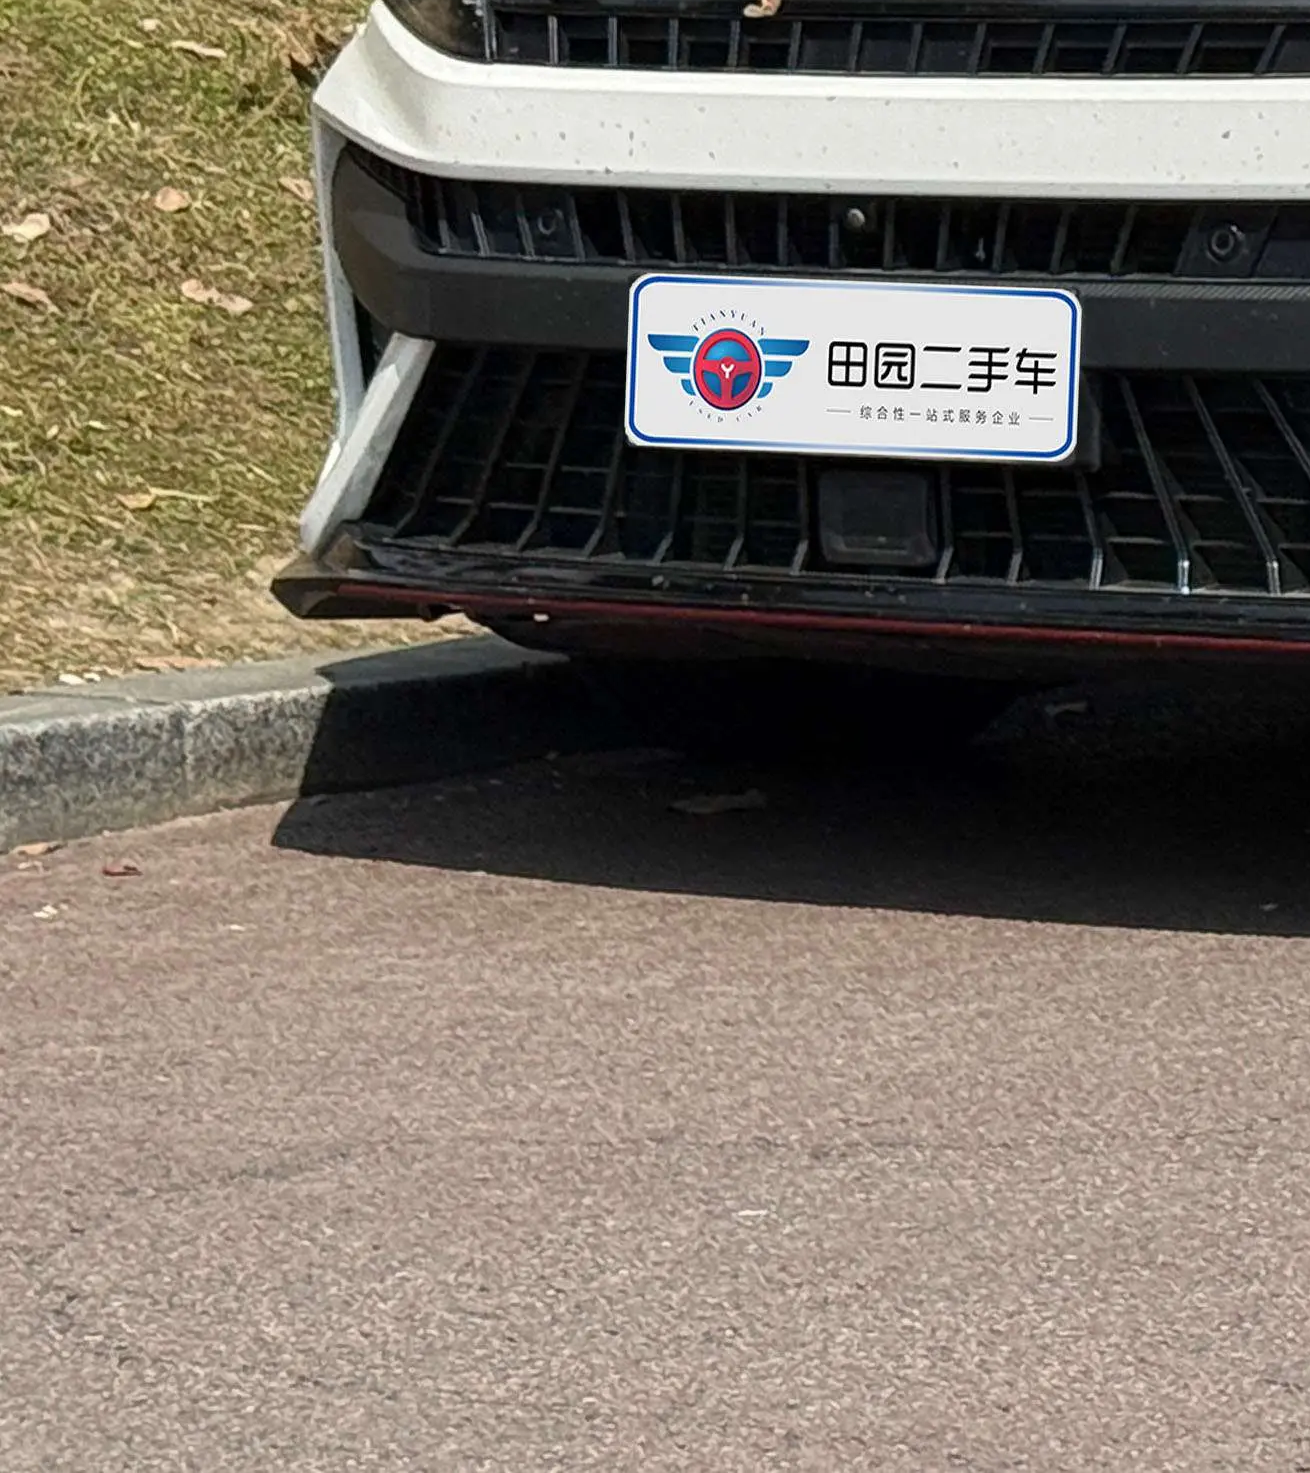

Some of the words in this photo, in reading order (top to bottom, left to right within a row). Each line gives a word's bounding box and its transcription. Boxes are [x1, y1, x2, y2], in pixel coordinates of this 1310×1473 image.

[827, 340, 1058, 395] 田园二手车
[858, 404, 1021, 426] 综合性一站式服务企业
